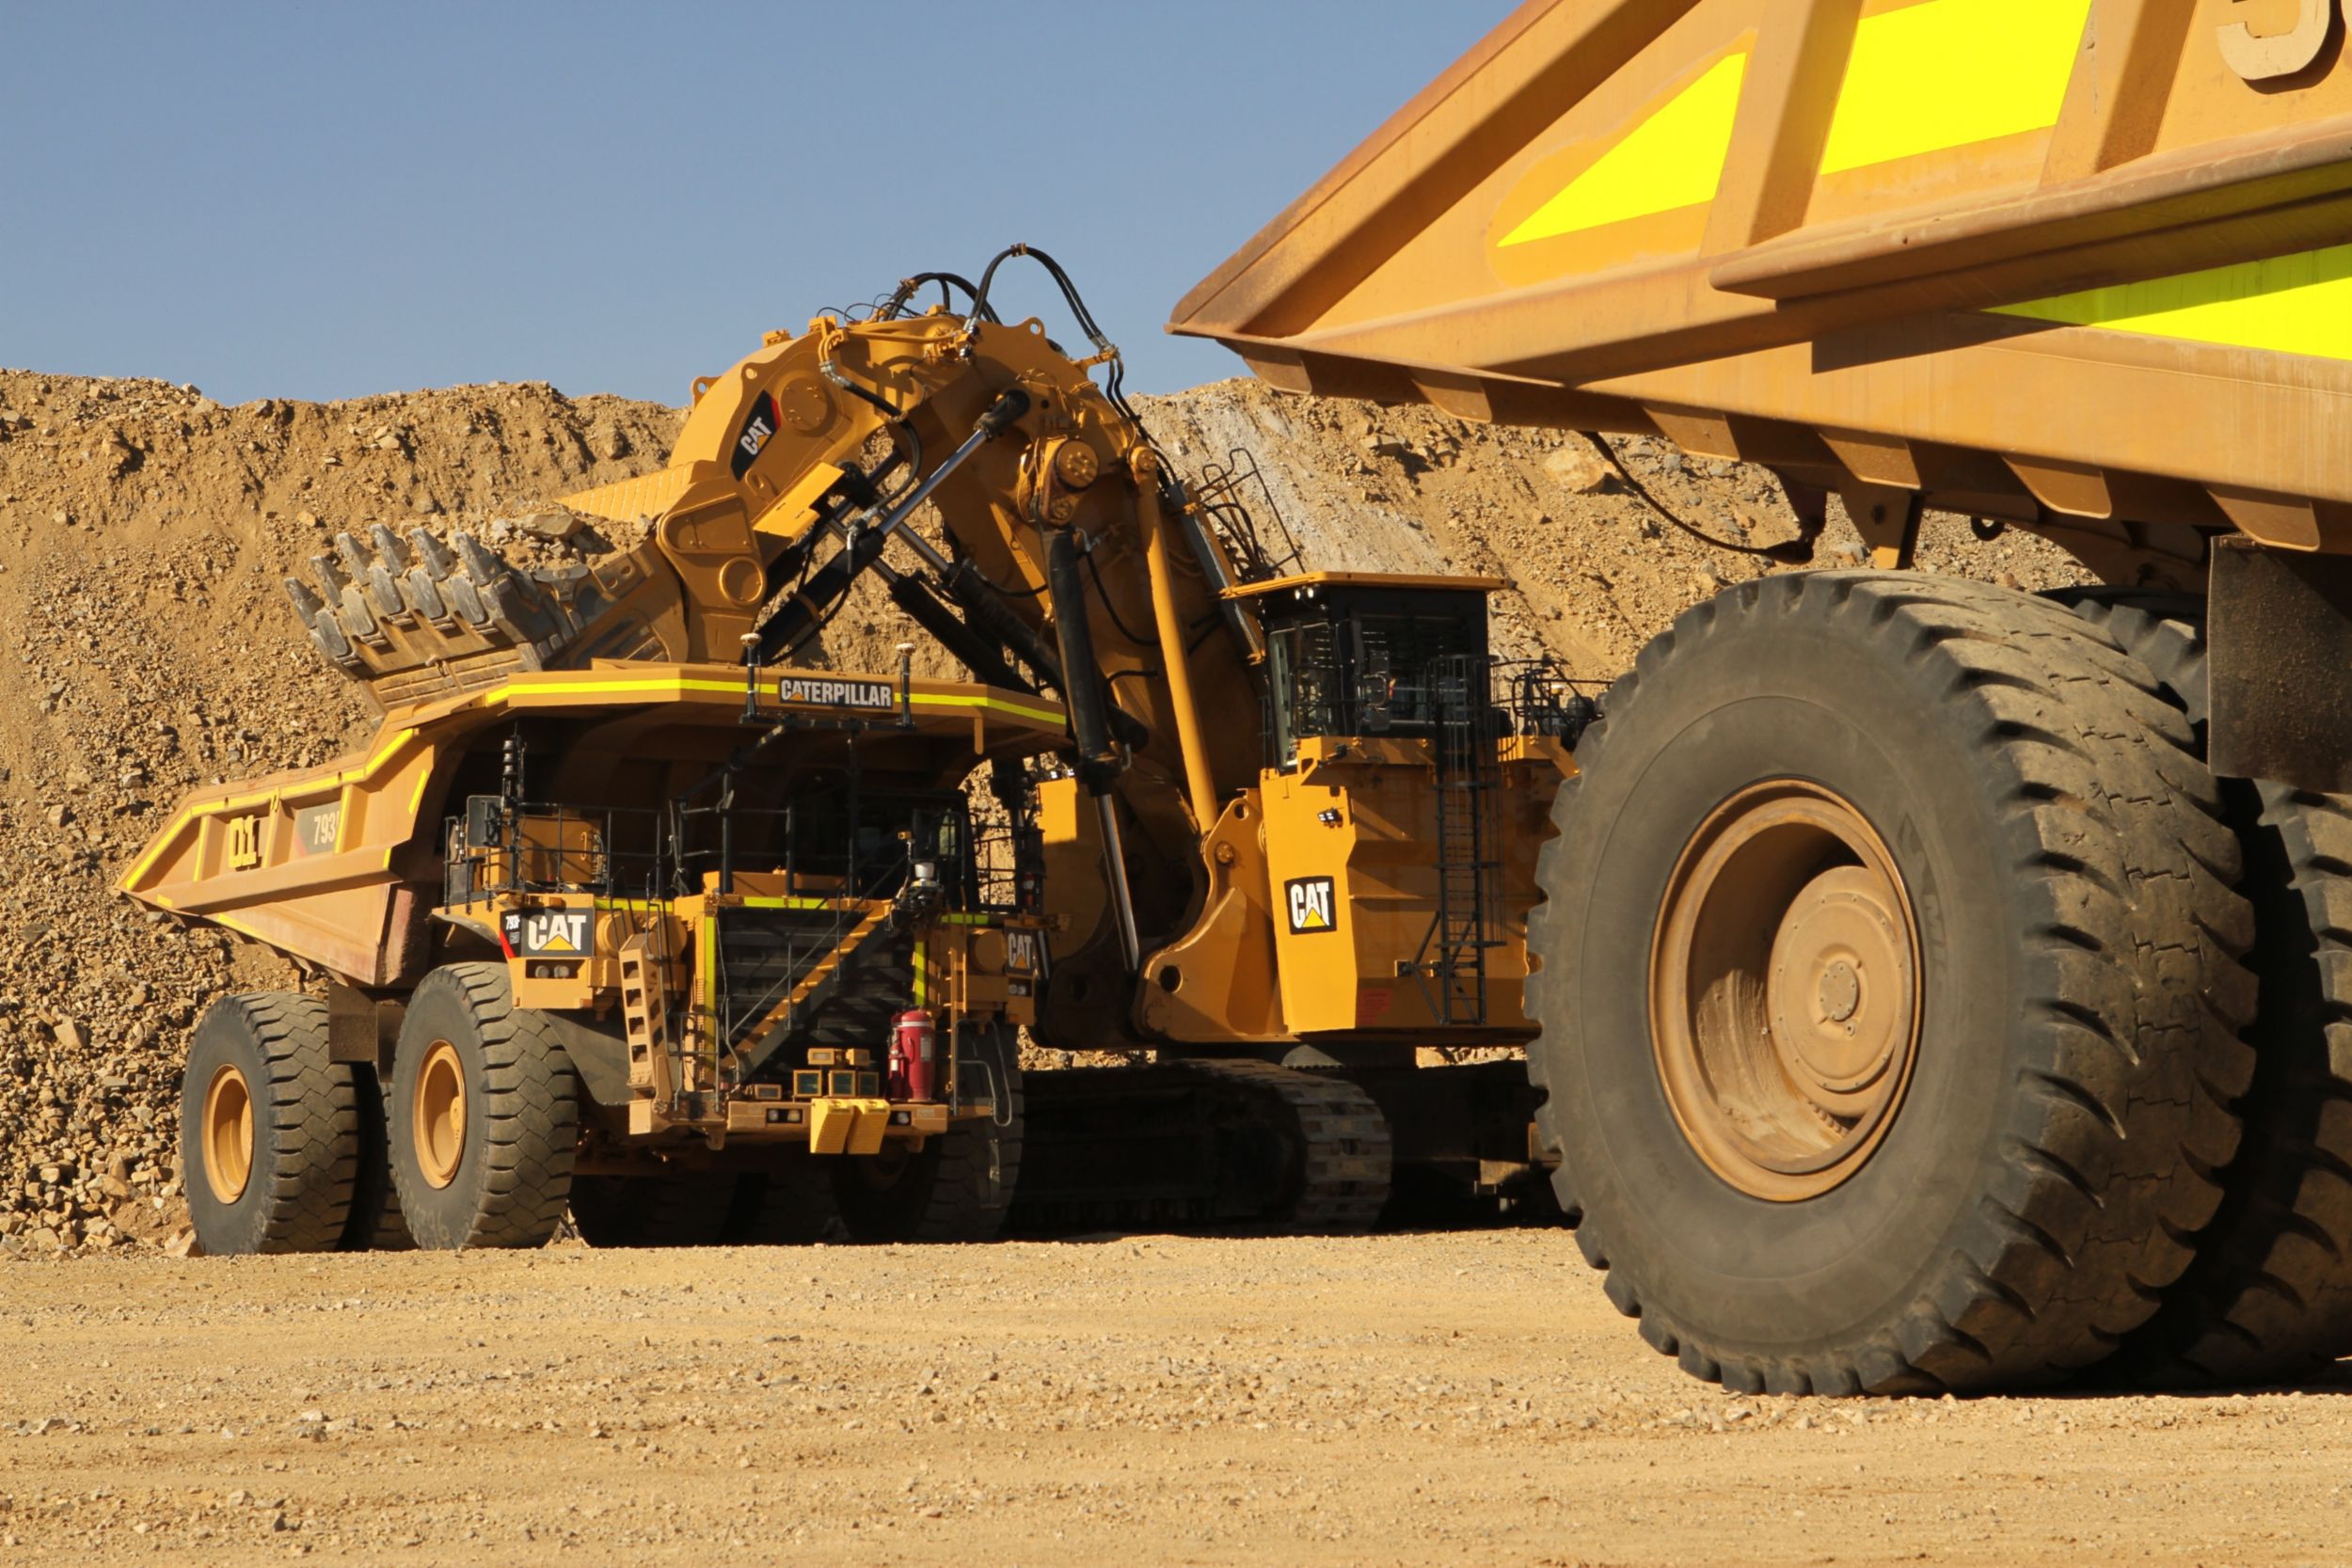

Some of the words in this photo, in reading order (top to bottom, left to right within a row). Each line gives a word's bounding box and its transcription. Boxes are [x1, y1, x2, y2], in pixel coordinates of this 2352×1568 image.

[740, 417, 772, 455] CAT
[780, 679, 892, 706] CATERPILLAR
[313, 811, 340, 845] 793
[1290, 882, 1330, 928] CAT
[528, 914, 587, 951] CAT
[1008, 932, 1032, 970] CAT
